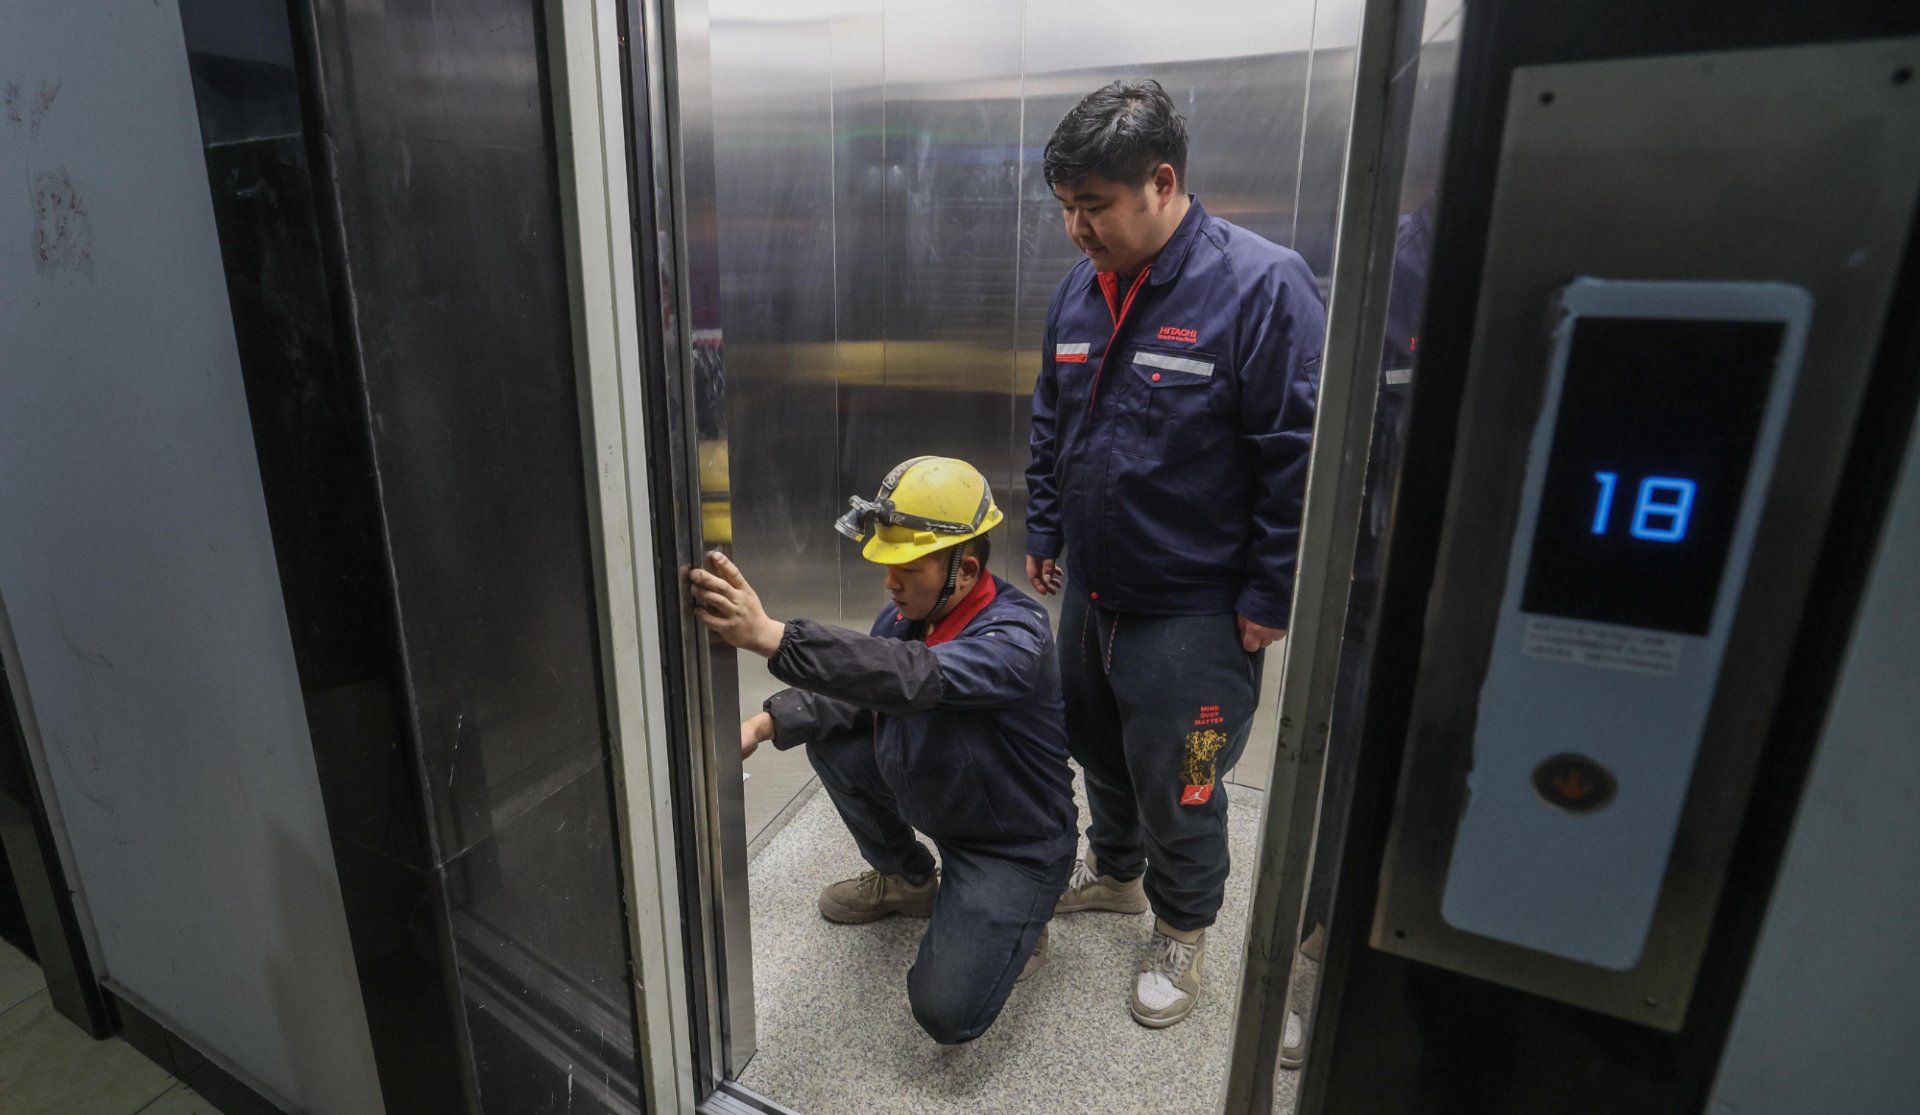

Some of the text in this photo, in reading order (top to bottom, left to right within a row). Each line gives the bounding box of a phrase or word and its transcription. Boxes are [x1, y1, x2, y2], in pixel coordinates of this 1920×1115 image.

[1159, 326, 1197, 338] HITACHI
[1592, 471, 1697, 542] 18
[1200, 711, 1219, 719] OVER
[1194, 717, 1224, 726] MATTER
